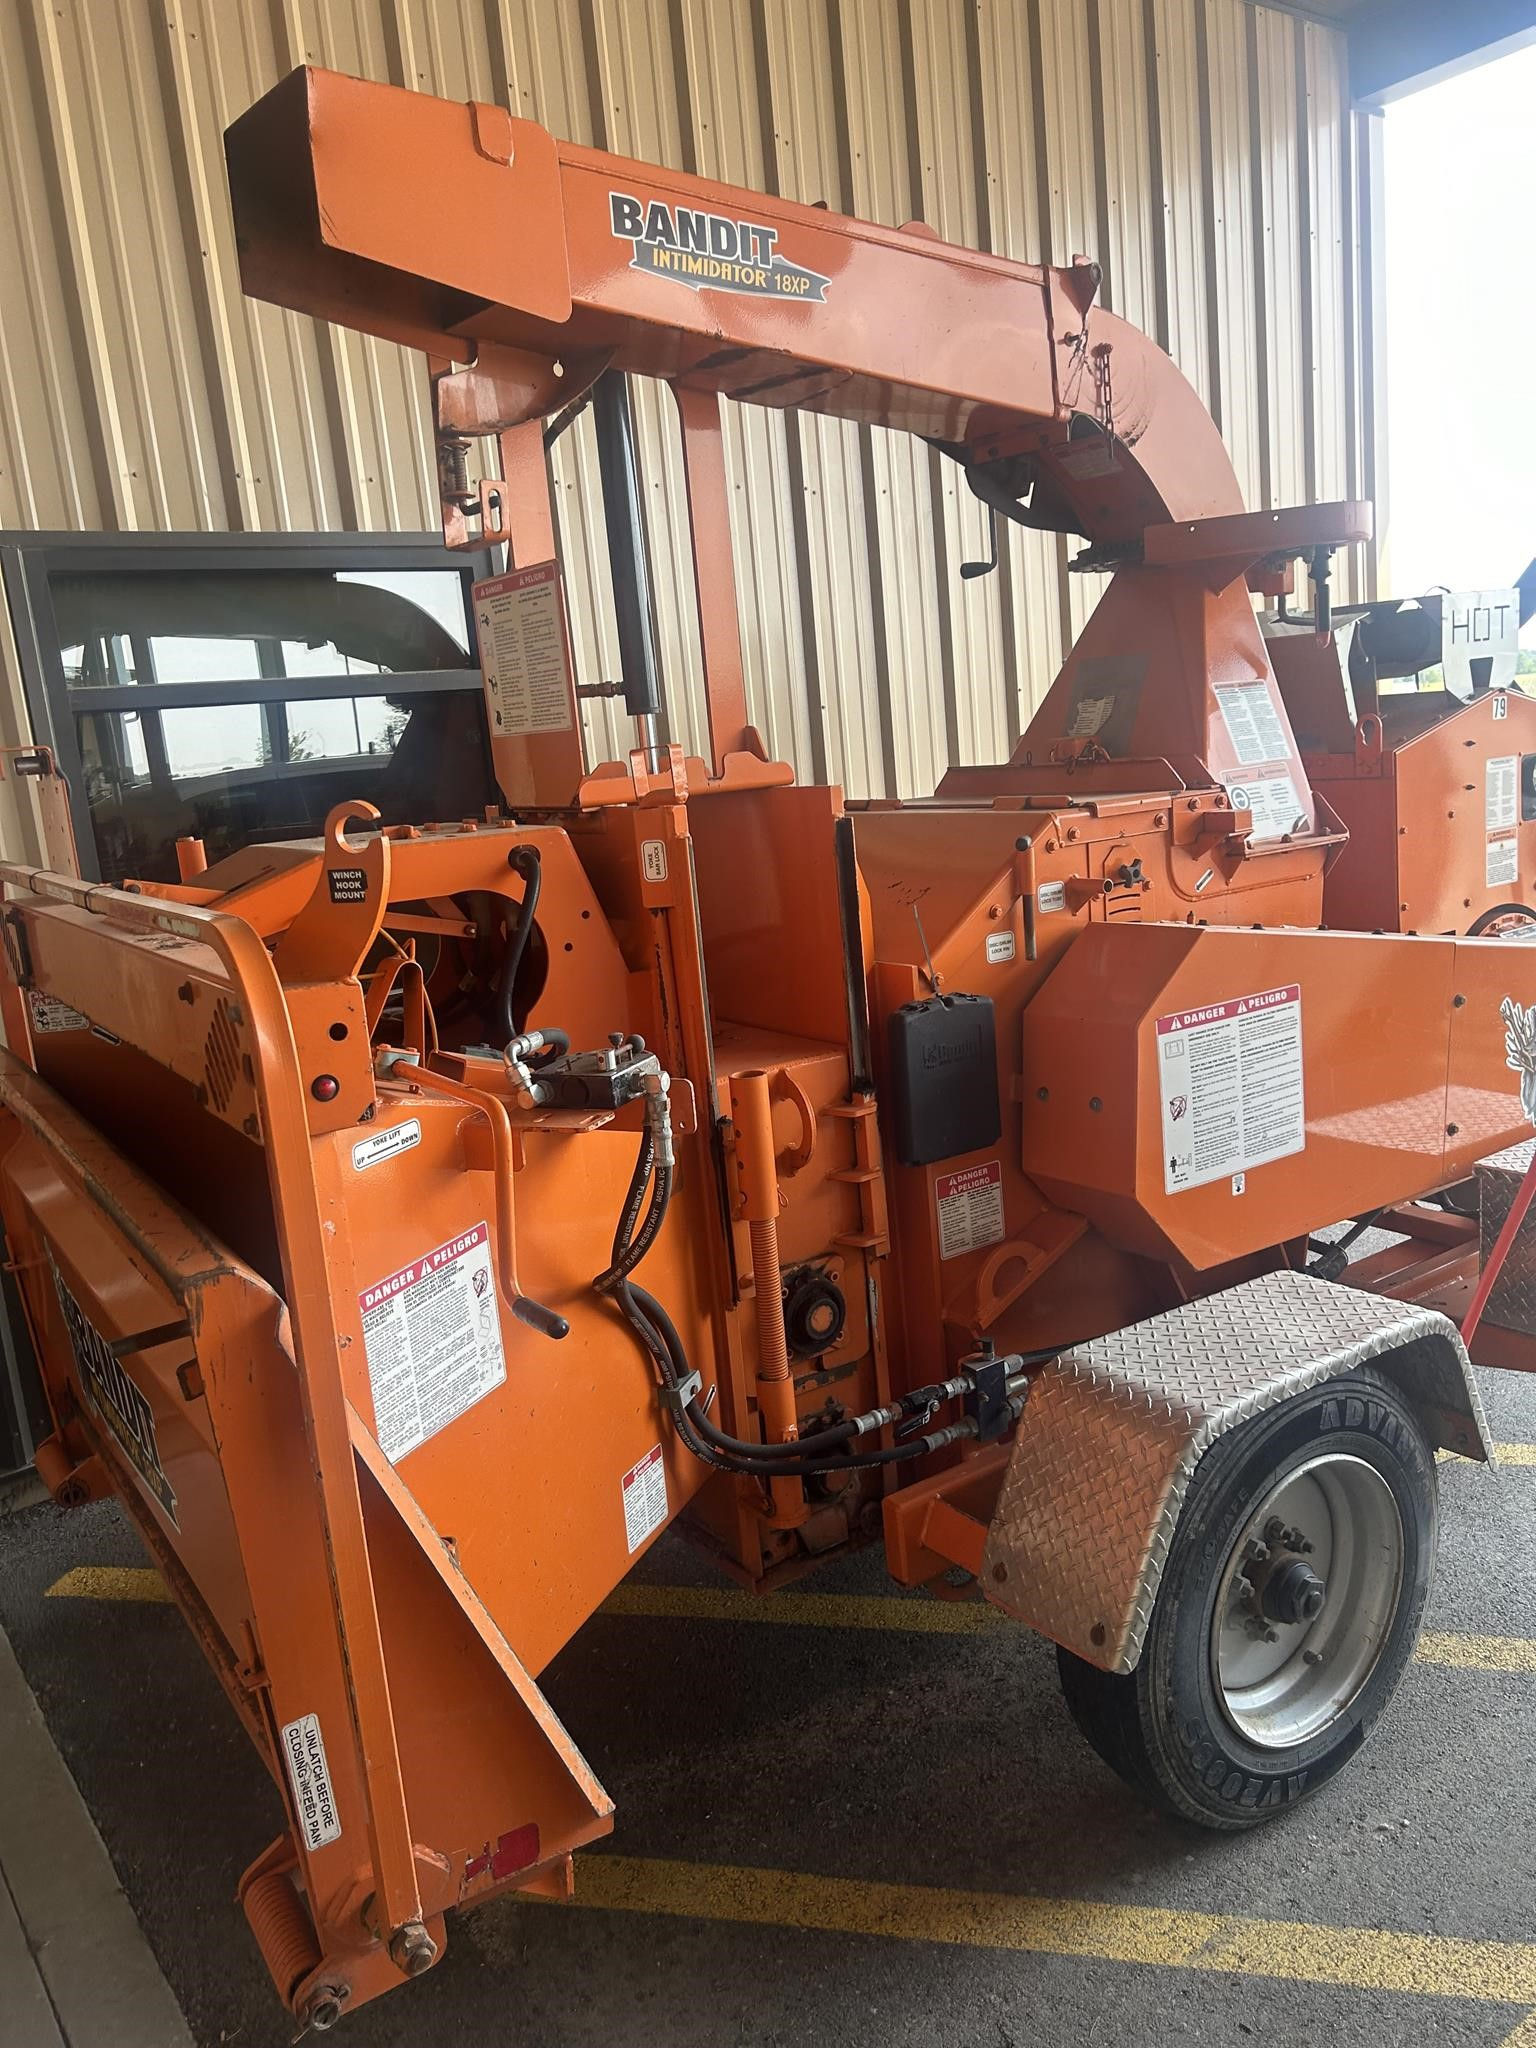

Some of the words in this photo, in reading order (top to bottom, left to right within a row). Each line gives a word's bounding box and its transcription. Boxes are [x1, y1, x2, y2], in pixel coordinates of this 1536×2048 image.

[610, 193, 777, 268] BANDIT
[652, 248, 767, 288] INTIMIDATOR
[774, 273, 810, 294] 18XP
[1452, 605, 1510, 645] HOT
[1494, 698, 1506, 718] 79
[332, 871, 362, 880] WINCH
[334, 892, 366, 900] MOUNT
[336, 882, 362, 890] HOOK
[1248, 990, 1288, 1008] PELIGRO
[1184, 1006, 1226, 1025] DANGER
[372, 1136, 387, 1147] YOKE
[389, 1130, 401, 1141] LIFT
[401, 1133, 418, 1145] DOWN
[357, 1156, 366, 1165] UP
[957, 1168, 988, 1183] DANGER
[958, 1176, 990, 1192] PELIGRO
[631, 1185, 644, 1209] FLAME
[622, 1210, 637, 1244] RESISTANT
[625, 1245, 642, 1266] FLAME
[638, 1208, 660, 1247] RESISTANT
[655, 1180, 665, 1202] MSHA
[433, 1232, 479, 1266] PELIGRO
[366, 1270, 415, 1307] DANGER
[289, 1728, 307, 1779] CLOSING
[300, 1778, 316, 1819] INFEED
[309, 1819, 321, 1844] PAN
[305, 1729, 324, 1782] UNLATCH
[316, 1782, 334, 1828] BEFORE
